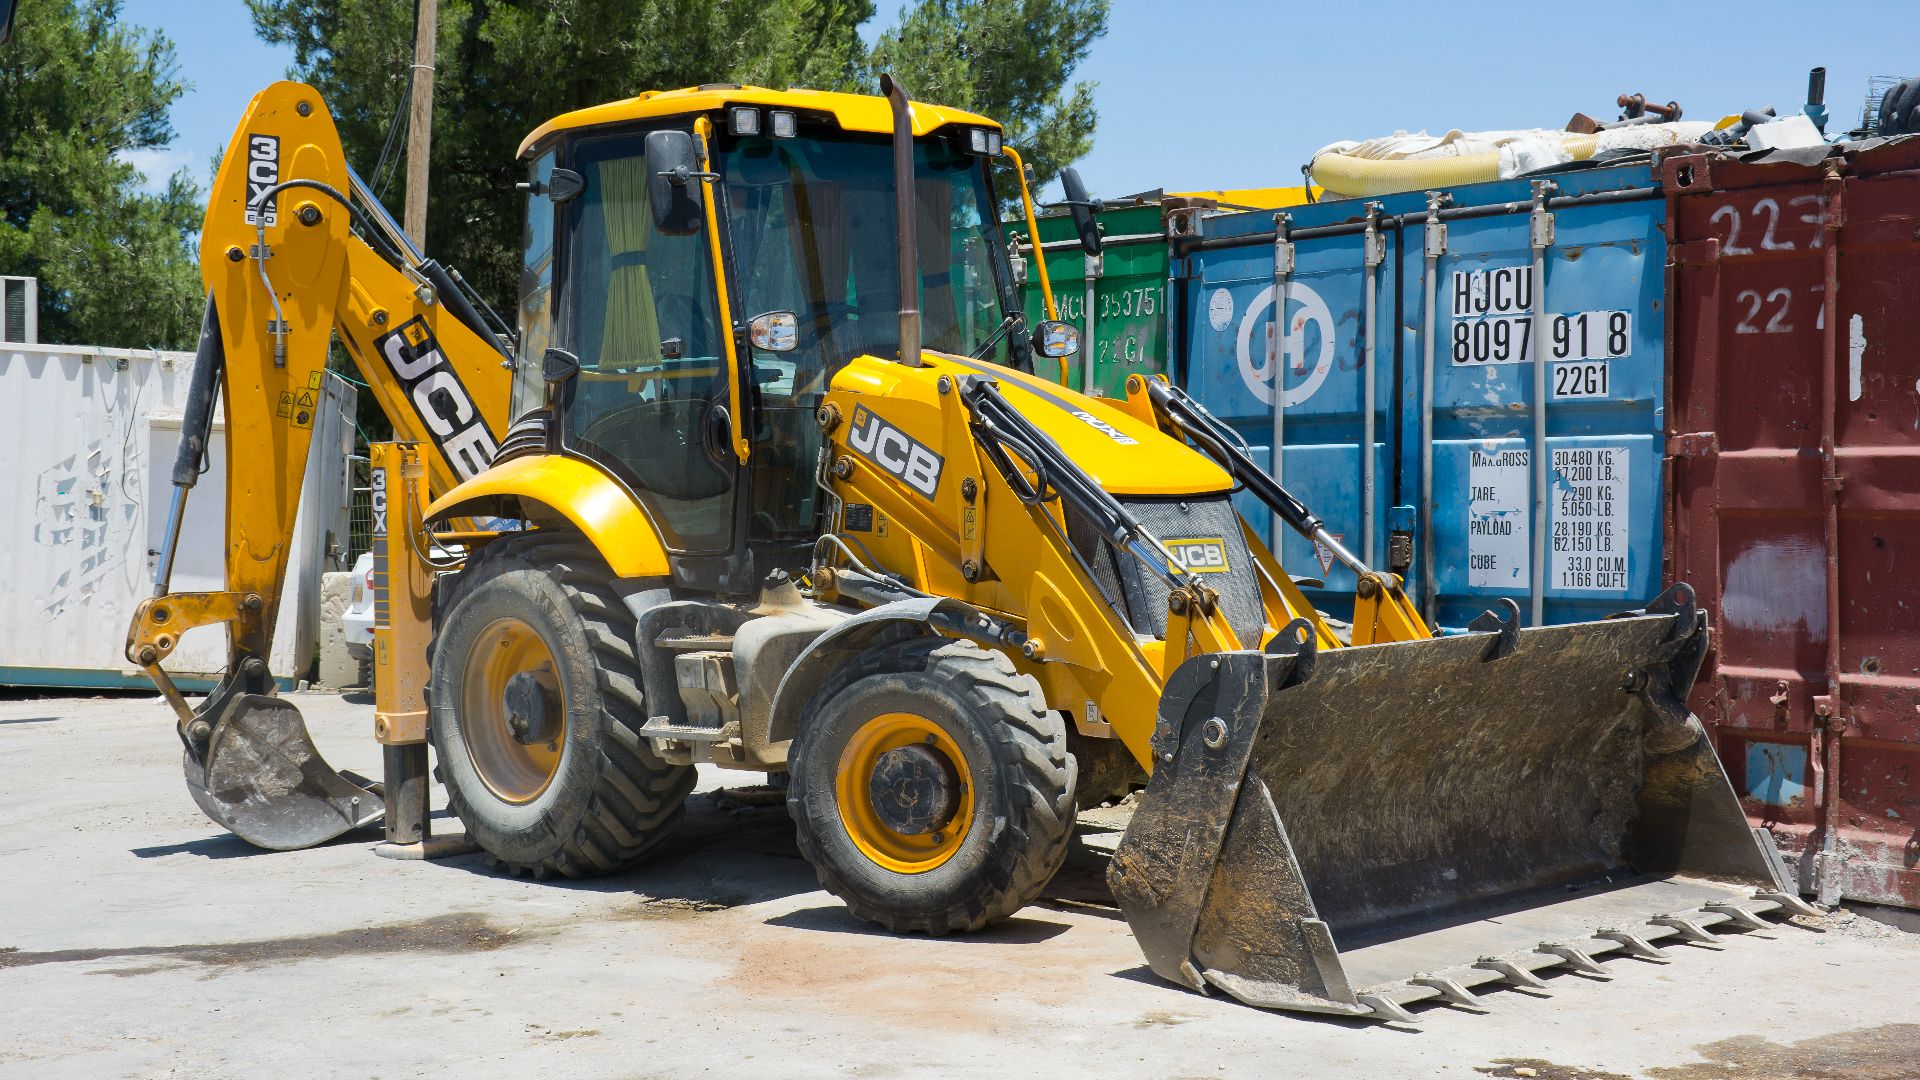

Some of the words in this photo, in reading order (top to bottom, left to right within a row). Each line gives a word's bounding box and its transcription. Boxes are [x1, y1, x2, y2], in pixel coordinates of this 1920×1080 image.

[247, 136, 278, 207] 3CX
[247, 214, 275, 224] EO
[1454, 267, 1533, 315] HJCU
[1555, 364, 1607, 396] 22G1
[850, 416, 941, 495] JCB
[1597, 450, 1615, 466] KG.
[1597, 466, 1614, 481] LB.
[372, 469, 387, 533] 3CX
[1471, 486, 1496, 501] TARE
[1597, 485, 1615, 501] KG.
[1597, 501, 1614, 517] LB.
[1470, 520, 1512, 536] PAYLOAD
[1597, 521, 1614, 537] KG.
[1597, 536, 1614, 552] LB.
[1177, 543, 1223, 567] JCB
[1470, 554, 1497, 570] CUBE
[1567, 556, 1592, 572] 33.0
